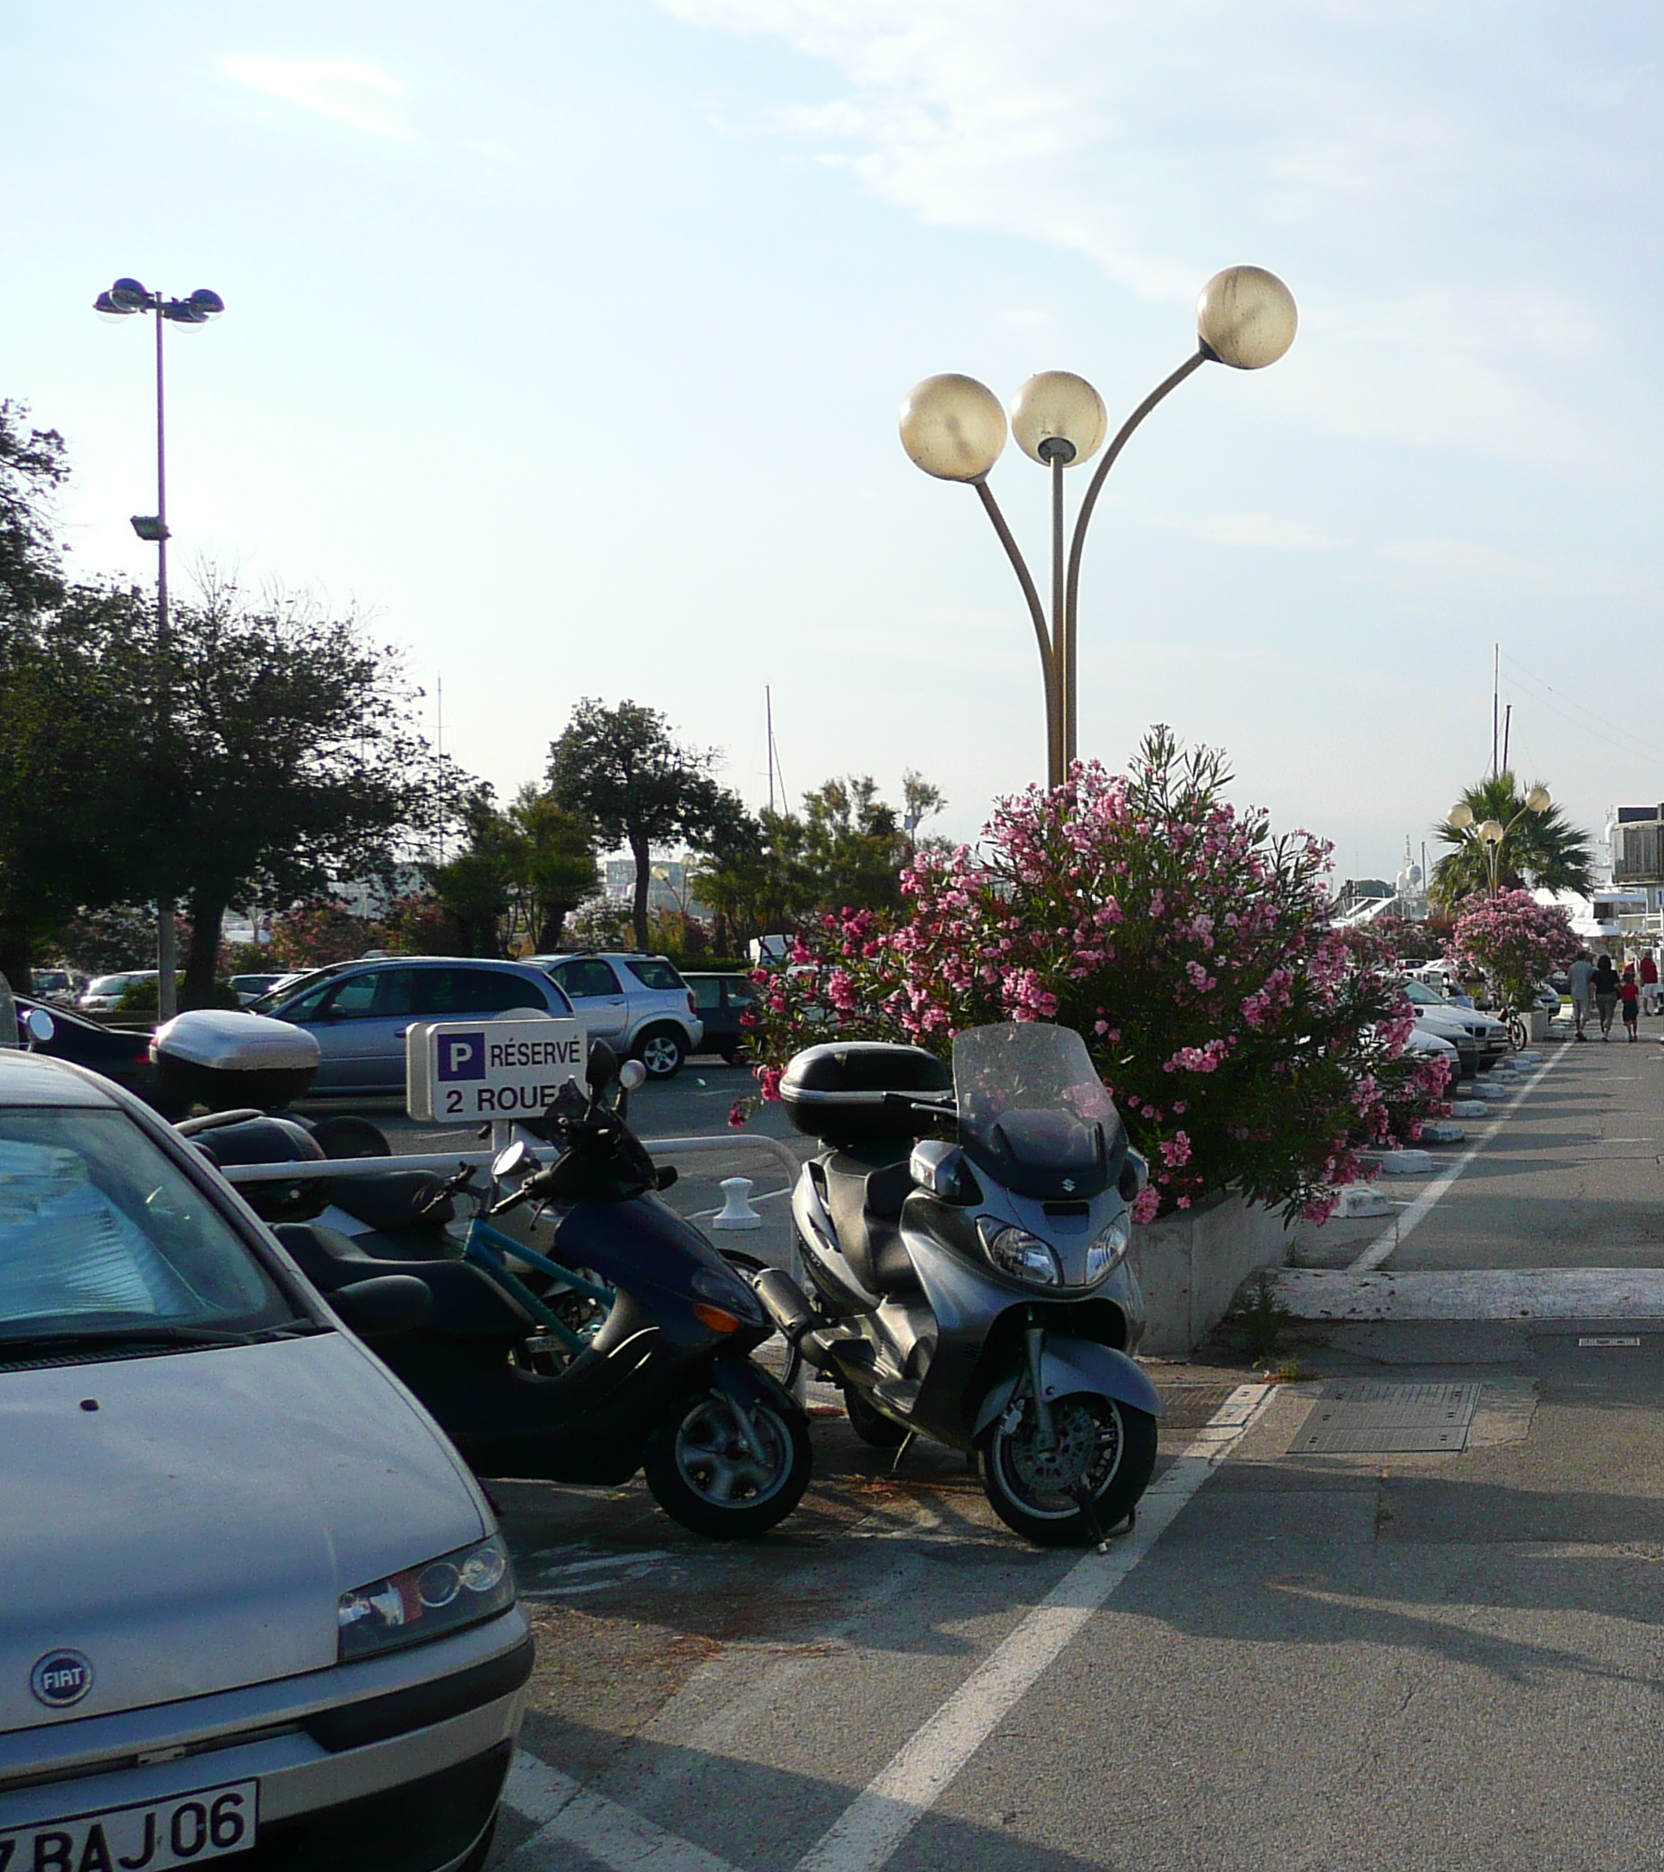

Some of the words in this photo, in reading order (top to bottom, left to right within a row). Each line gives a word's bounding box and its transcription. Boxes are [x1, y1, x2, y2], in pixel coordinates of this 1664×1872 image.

[450, 1043, 473, 1072] P
[490, 1034, 581, 1067] RÉSERVÉ
[446, 1090, 463, 1113] 2
[43, 1667, 84, 1691] FIAT
